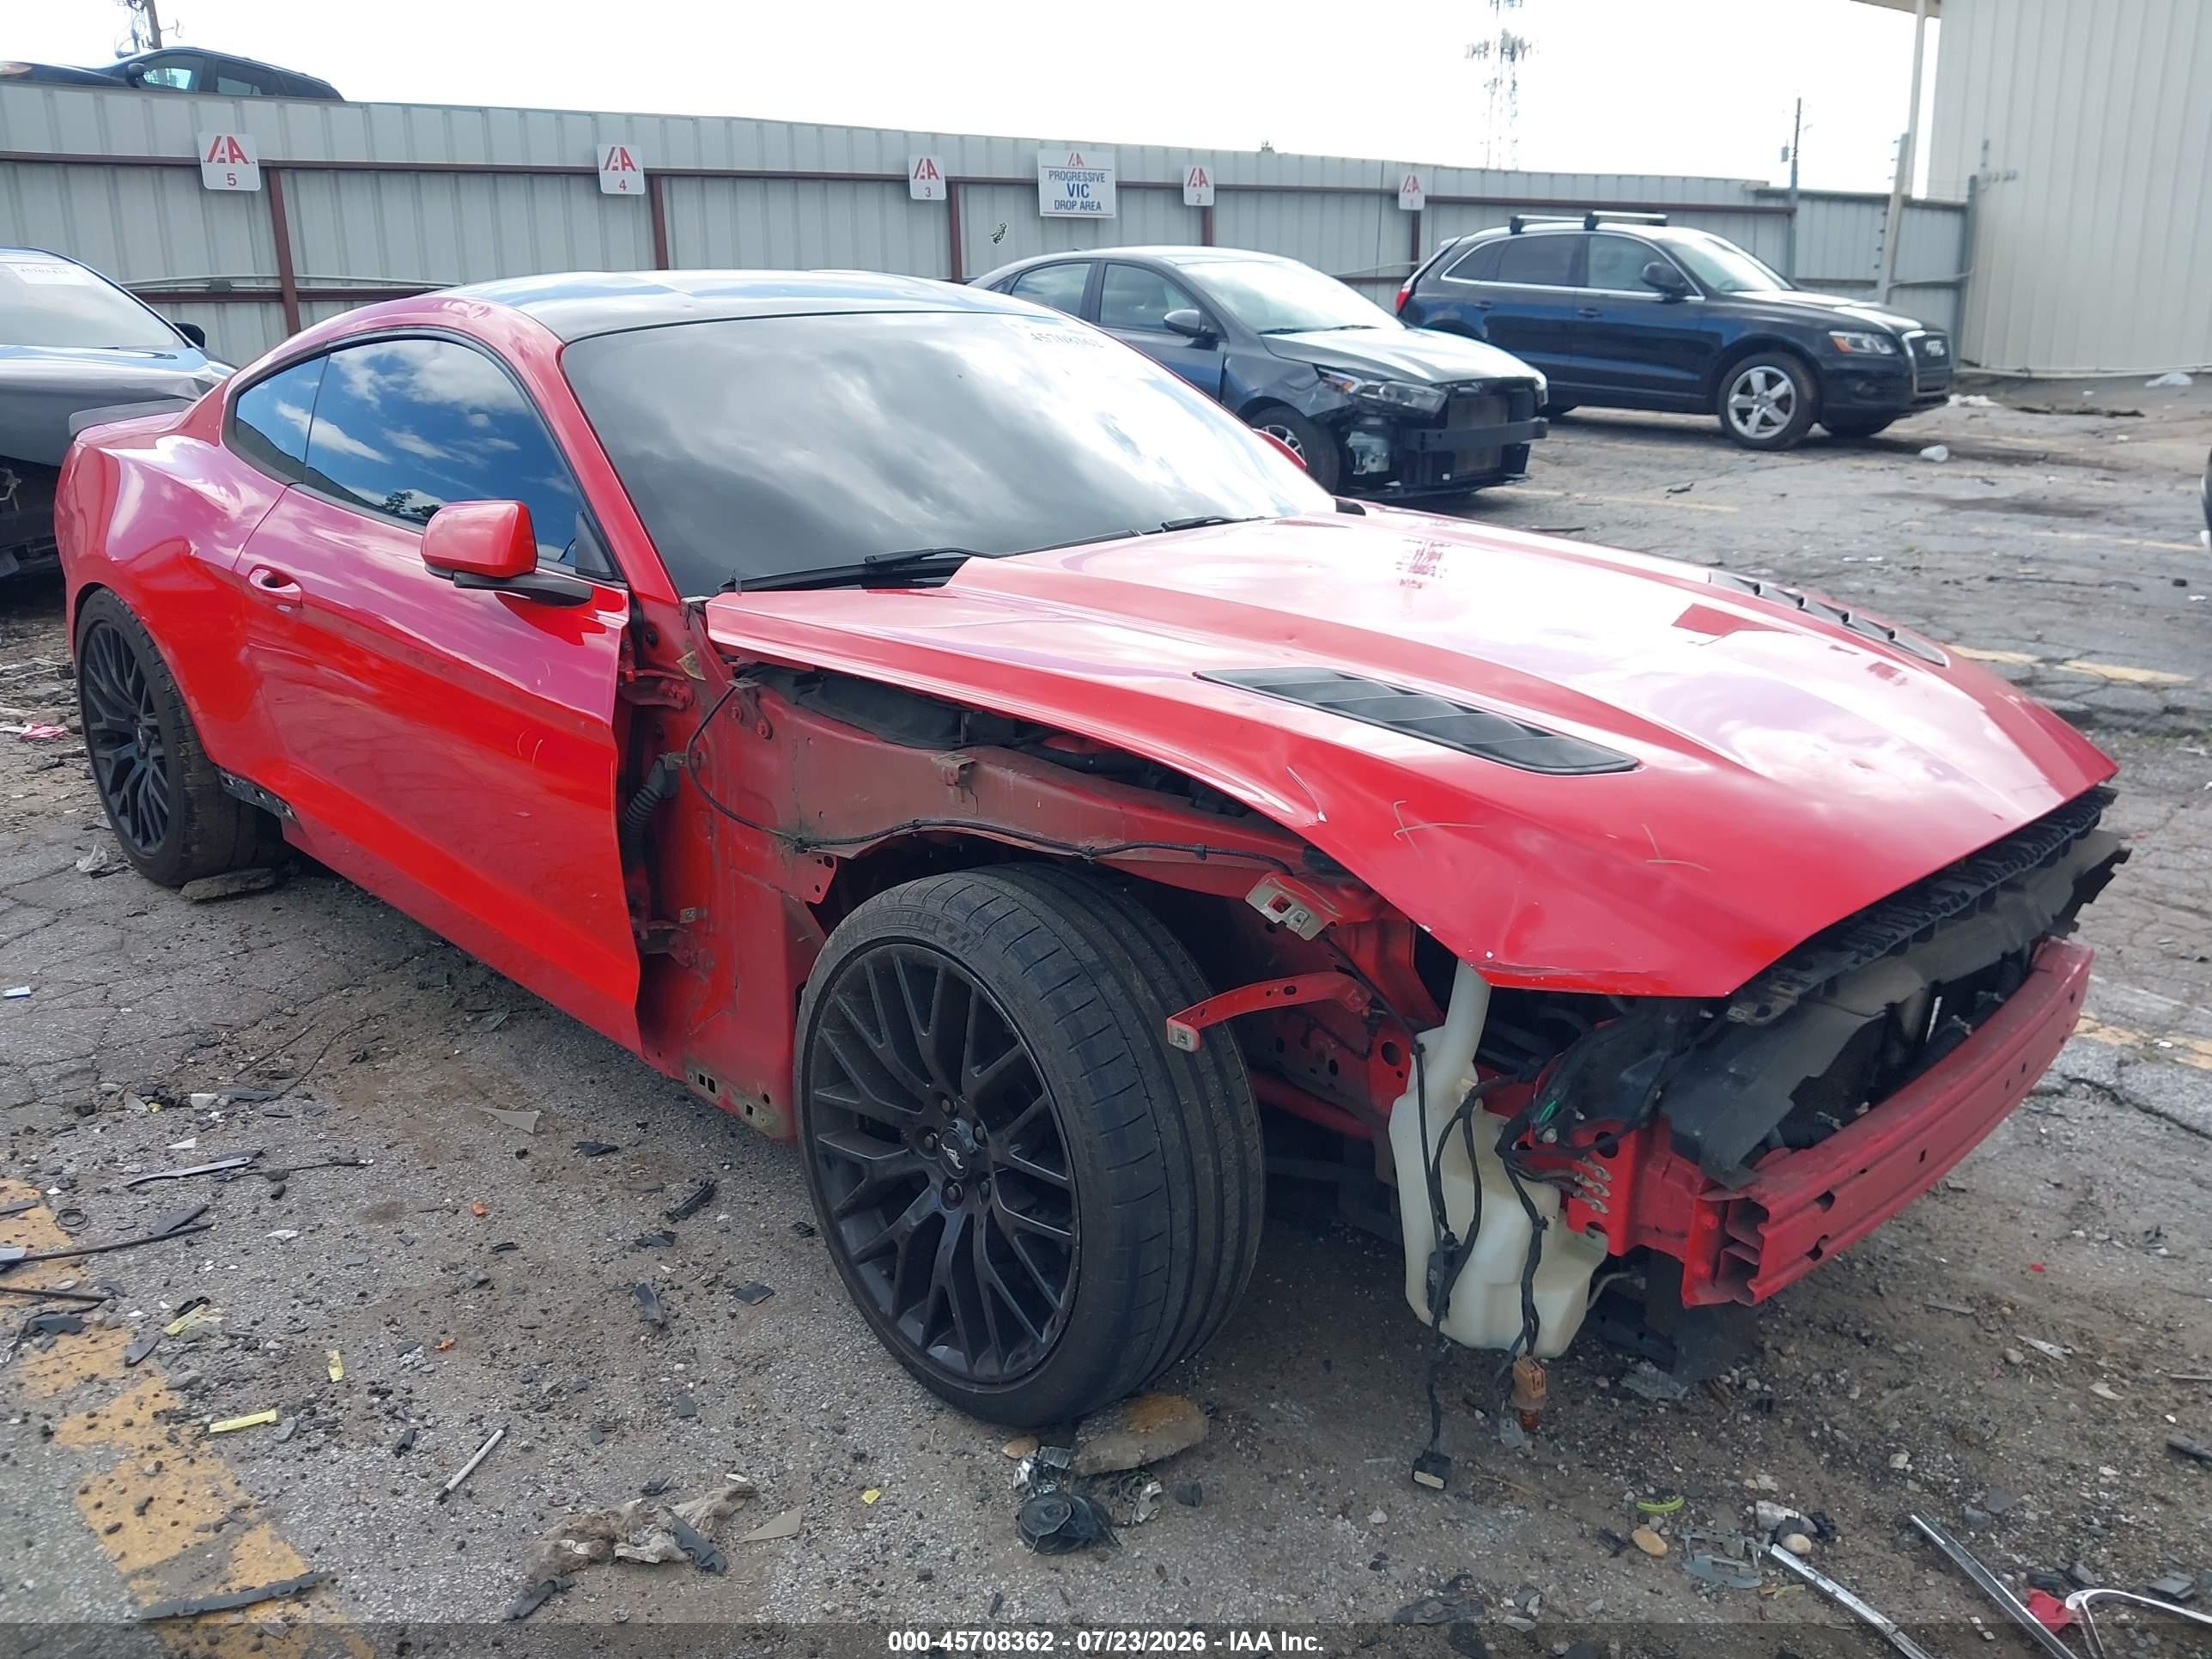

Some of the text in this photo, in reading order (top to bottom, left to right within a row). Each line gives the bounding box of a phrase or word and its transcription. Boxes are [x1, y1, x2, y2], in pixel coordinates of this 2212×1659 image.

[227, 173, 237, 186] 5
[1048, 170, 1106, 183] PROGRESSIVE
[619, 179, 627, 191] 4
[1066, 183, 1090, 198] VIC
[925, 186, 932, 198] 3
[1195, 193, 1202, 204] 2
[1054, 199, 1102, 211] DROP AREA
